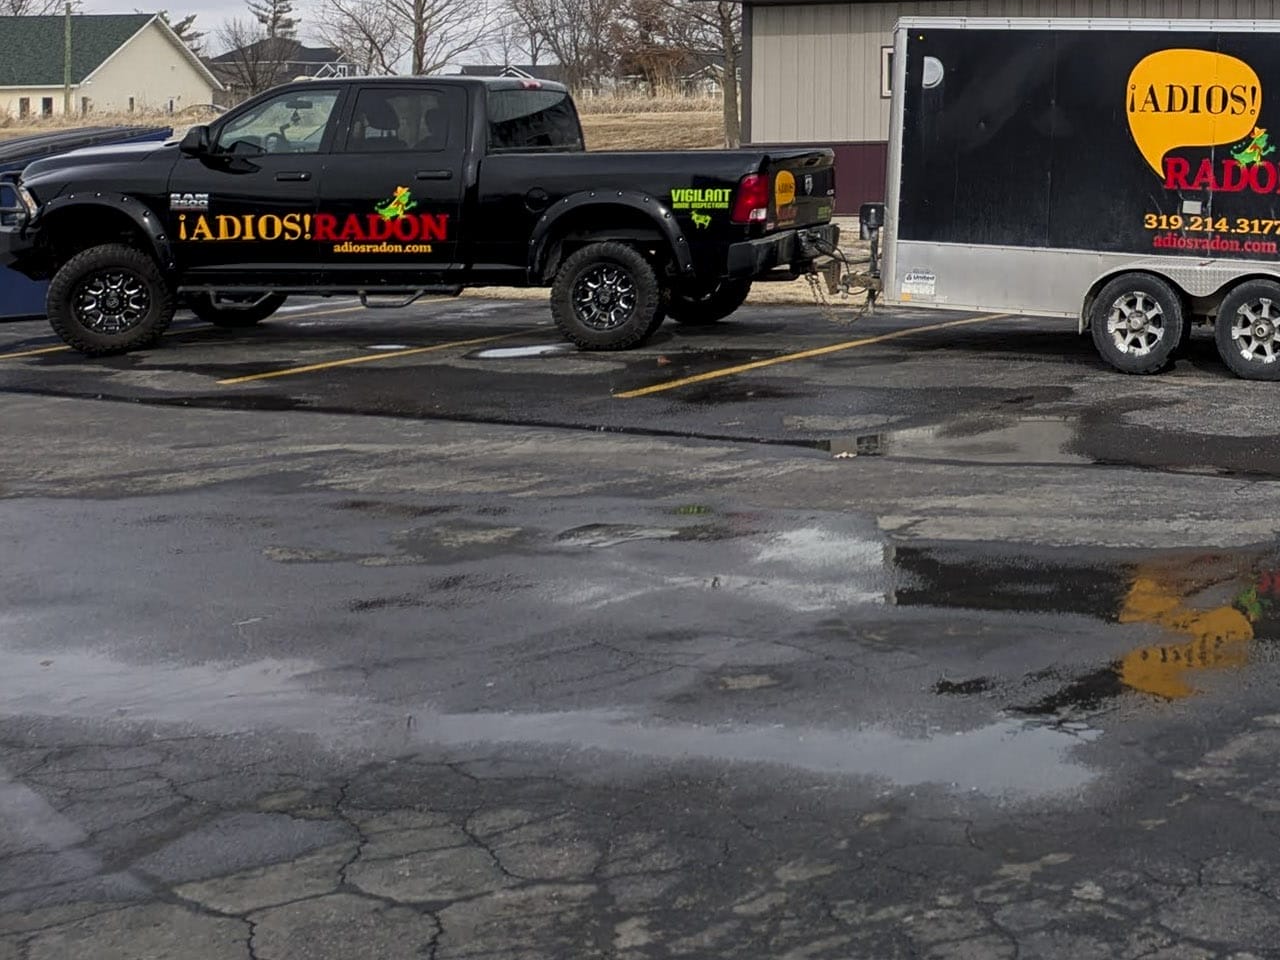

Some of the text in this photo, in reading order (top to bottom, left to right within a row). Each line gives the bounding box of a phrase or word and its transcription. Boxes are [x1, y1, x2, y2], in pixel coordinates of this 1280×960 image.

[1129, 84, 1258, 116] ¡ADIOS!
[671, 189, 732, 202] VIGILANT
[312, 213, 450, 241] RADON
[333, 241, 432, 253] adiosradon.com
[1152, 233, 1278, 254] adiosradon.com
